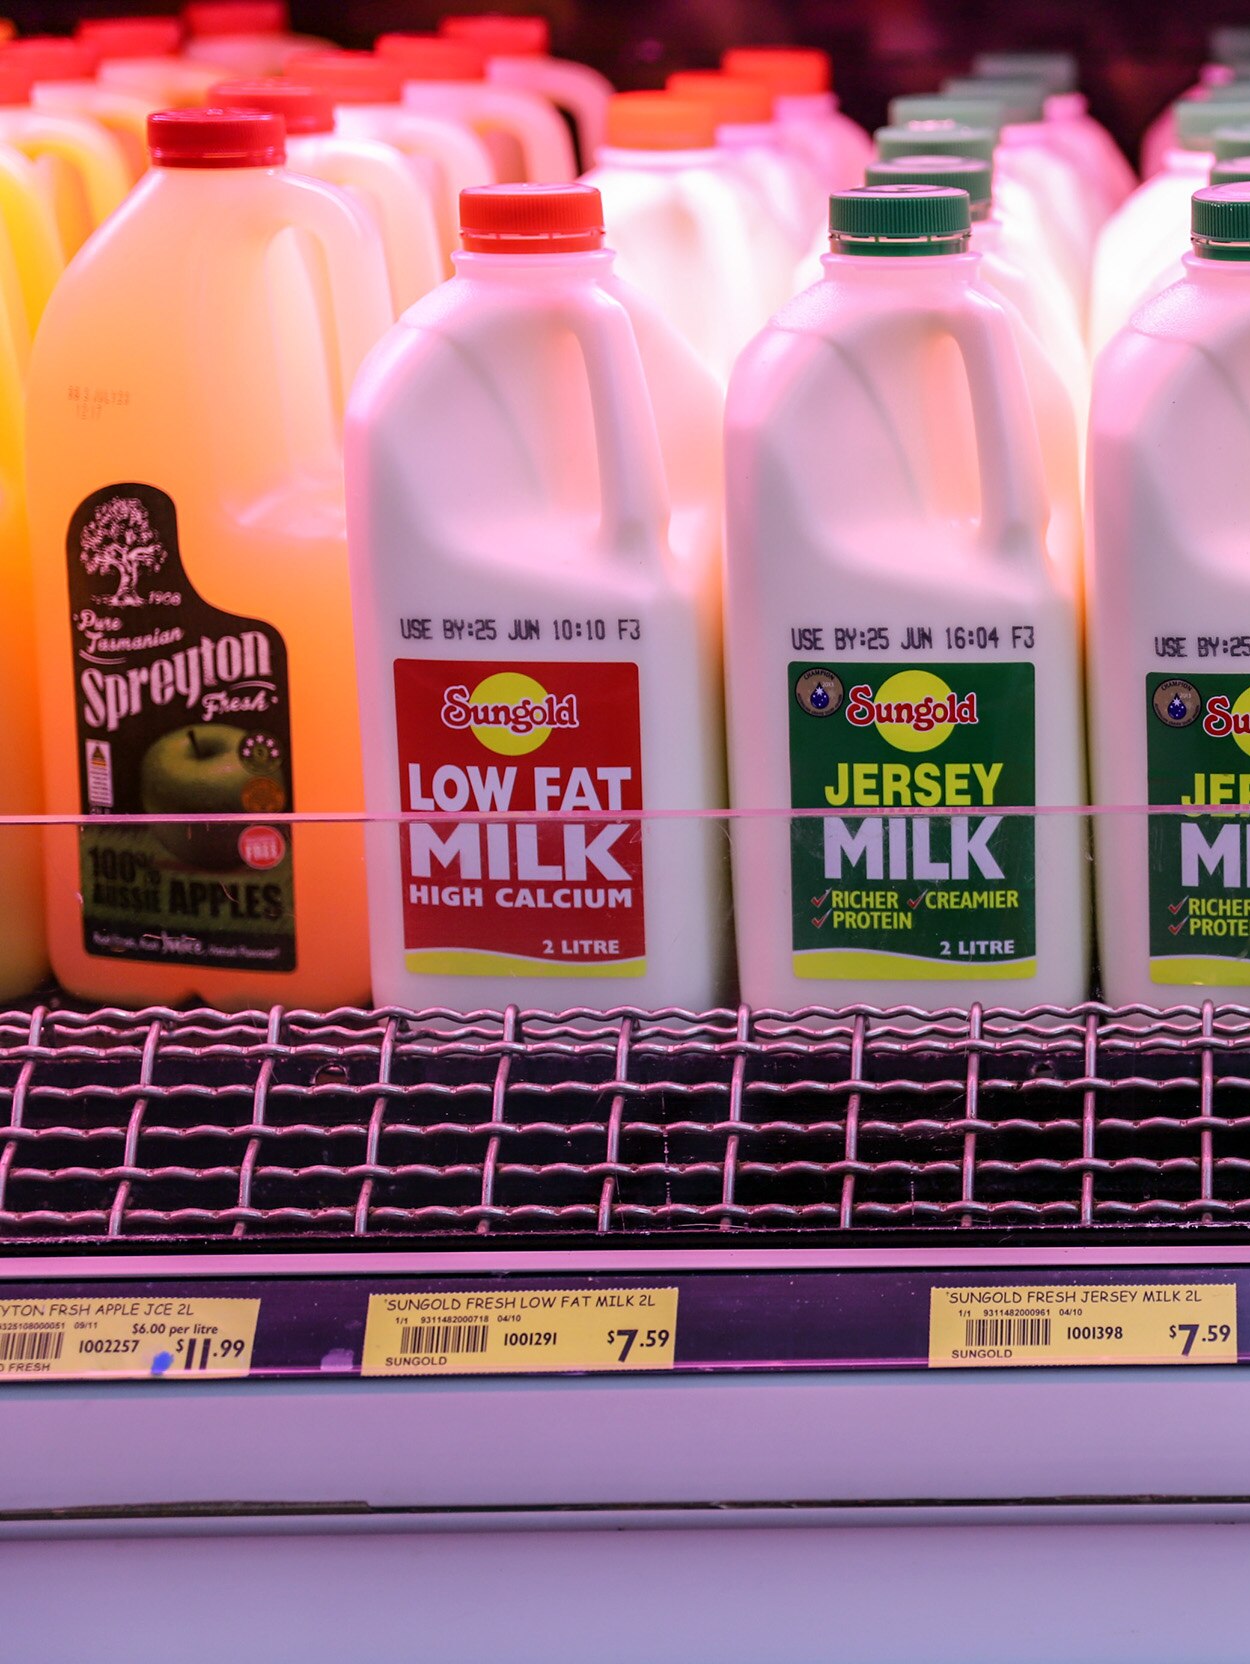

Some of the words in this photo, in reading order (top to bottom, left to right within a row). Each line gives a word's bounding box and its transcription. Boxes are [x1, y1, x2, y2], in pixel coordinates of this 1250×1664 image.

[77, 609, 123, 631] Pure
[401, 619, 432, 639] USE
[443, 619, 496, 640] BY:25
[508, 619, 540, 640] JUN
[554, 620, 605, 640] 10:10
[618, 619, 640, 640] F3
[85, 627, 184, 654] Tasmanian
[792, 628, 824, 650] USE
[835, 628, 889, 650] BY:25
[901, 628, 932, 649] JUN
[946, 626, 998, 649] 16:04
[1012, 626, 1035, 648] F3
[1155, 636, 1187, 657] USE
[81, 631, 272, 732] Spreyton
[804, 670, 834, 681] CHAMPION
[1161, 681, 1192, 691] CHAMPION
[202, 690, 268, 721] Fresh
[441, 685, 579, 735] Sungold
[846, 685, 978, 731] Sungold
[409, 763, 517, 812] LOW
[534, 767, 631, 811] FAT
[825, 763, 1003, 807] JERSEY
[409, 823, 632, 881] MILK
[824, 815, 1005, 880] MILK
[88, 847, 162, 886] 100%
[169, 879, 282, 920] APPLES
[410, 885, 483, 907] HIGH
[496, 888, 632, 908] CALCIUM
[831, 891, 898, 909] RICHER
[925, 890, 1018, 909] CREAMIER
[833, 911, 912, 929] PROTEIN
[543, 940, 554, 954] 2
[562, 940, 619, 954] LITRE
[940, 942, 951, 955] 2
[958, 940, 1014, 955] LITRE
[466, 1297, 515, 1309] FRESH
[520, 1297, 556, 1308] LOW
[561, 1296, 591, 1308] FAT
[595, 1295, 634, 1307] MILK
[639, 1295, 655, 1306] 2L
[1027, 1291, 1075, 1303] FRESH
[1081, 1291, 1137, 1302] JERSEY
[1142, 1291, 1181, 1302] MILK
[1185, 1291, 1202, 1302] 2L
[49, 1304, 90, 1316] FRSH
[95, 1303, 139, 1315] APPLE
[144, 1303, 172, 1315] JCE
[177, 1304, 194, 1315] 2L
[132, 1323, 165, 1334] $6.00
[169, 1325, 188, 1337] per
[193, 1323, 218, 1334] litre
[504, 1333, 557, 1346] 1001291
[1067, 1327, 1123, 1340] 1001398
[79, 1340, 140, 1353] 1002257
[951, 1350, 1012, 1358] SUNGOLD
[8, 1363, 50, 1372] FRESH
[386, 1357, 447, 1366] SUNGOLD
